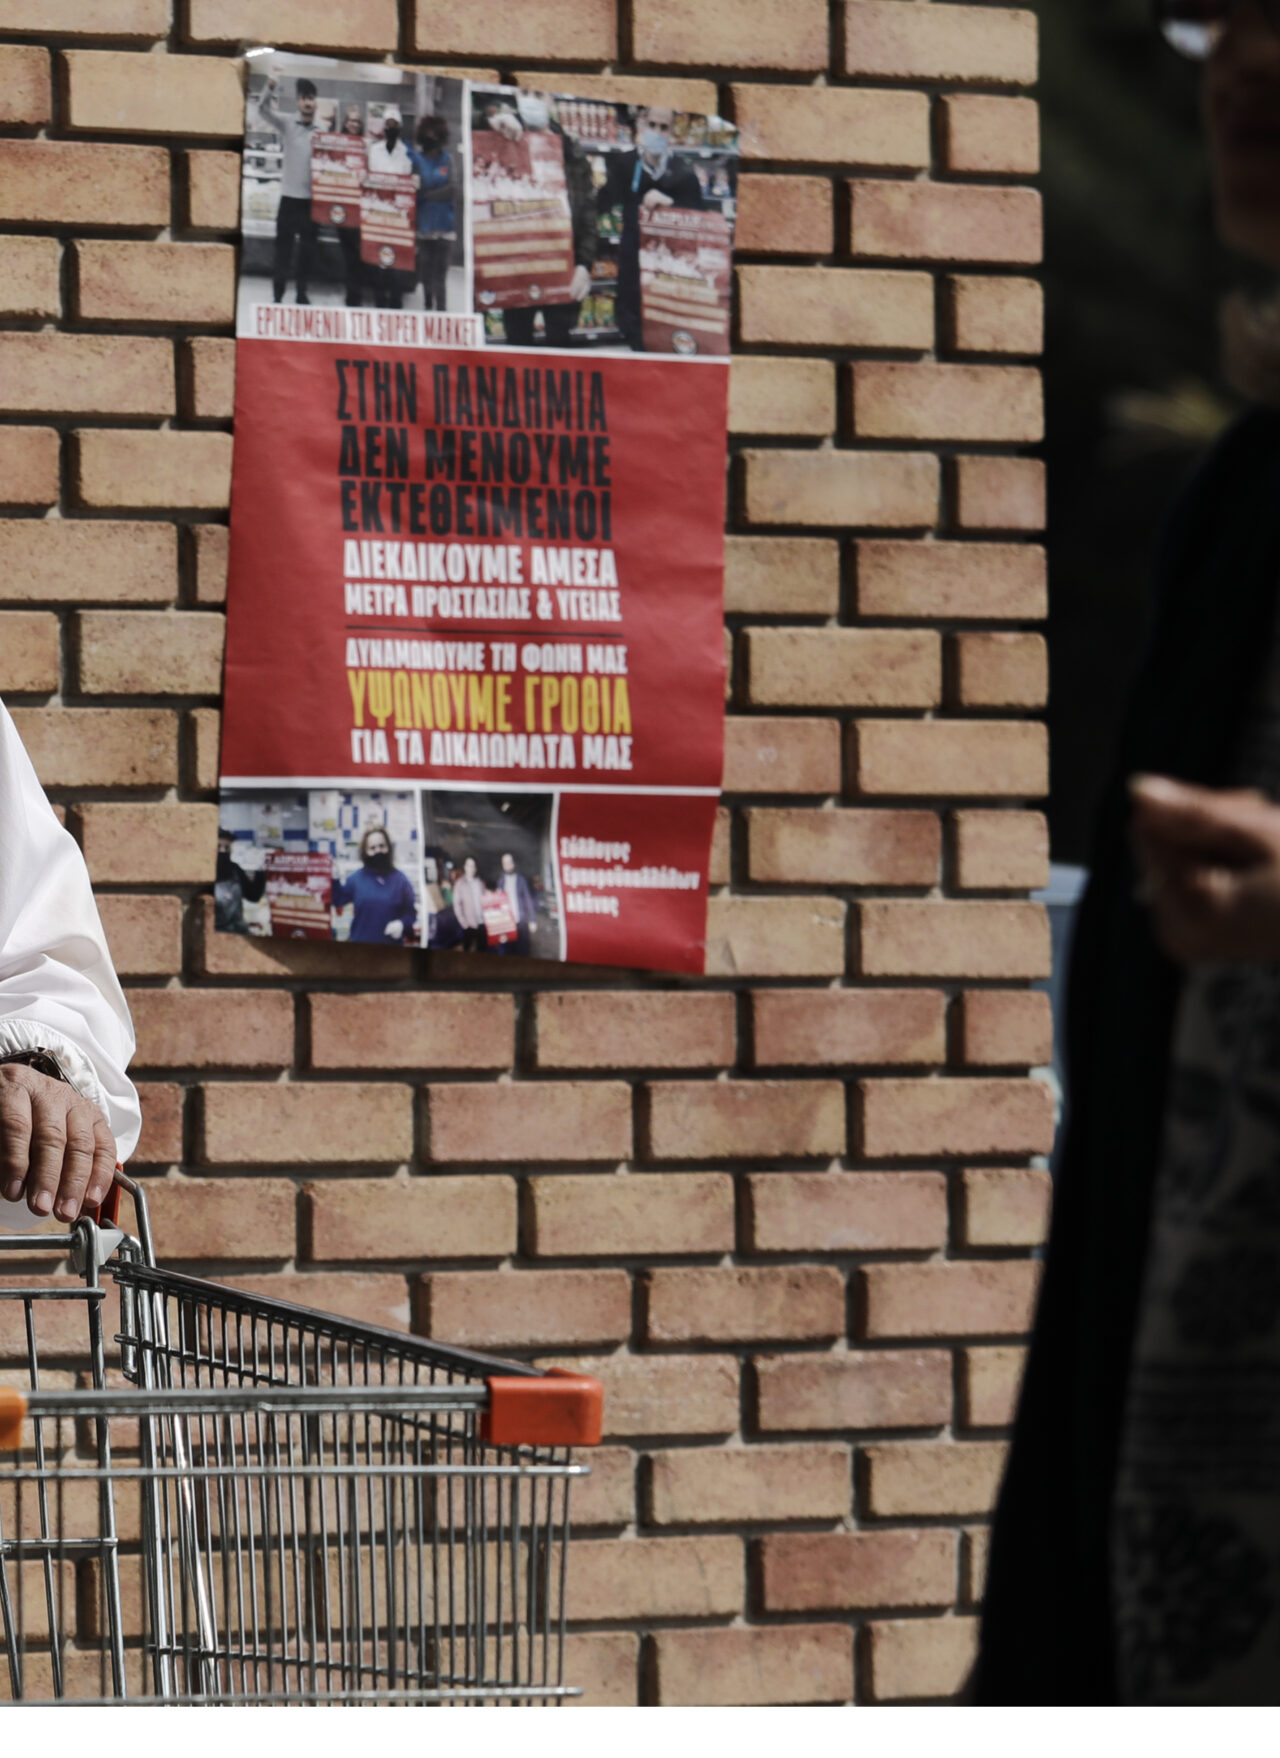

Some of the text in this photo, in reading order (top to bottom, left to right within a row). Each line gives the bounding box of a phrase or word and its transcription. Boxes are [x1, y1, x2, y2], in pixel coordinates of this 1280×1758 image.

[256, 305, 477, 346] ΕΡΓΑΖΟΜΕΝΟΙ ΣΤΑ SUPER MARKET
[335, 359, 608, 432] ΣΤΗΝ ΠΑΝΔΗΜΙΑ
[337, 425, 612, 487] ΔΕΝ ΜΕΝΟΥΜΕ
[340, 480, 612, 542] ΕΚΤΕΘΕΙΜΕΝΟΙ
[343, 539, 619, 588] ΔΙΕΚΔΙΚΟΥΜΕ ΑΜΕΣΑ
[344, 583, 623, 622] ΜΕΤΡΑ ΠΡΟΣΤΑΣΙΑΣ & ΥΓΕΙΑΣ
[345, 638, 628, 674] ΔΥΝΑΜΩΝΟΥΜΕ ΤΗ ΦΩΝΗ ΜΑΣ
[347, 670, 633, 735] ΥΨΩΝΟΥΜΕ ΓΡΟΘΙΑ
[351, 729, 634, 771] ΓΙΑ ΤΑ ΔΙΚΑΙΩΜΑΤΑ ΜΑΣ
